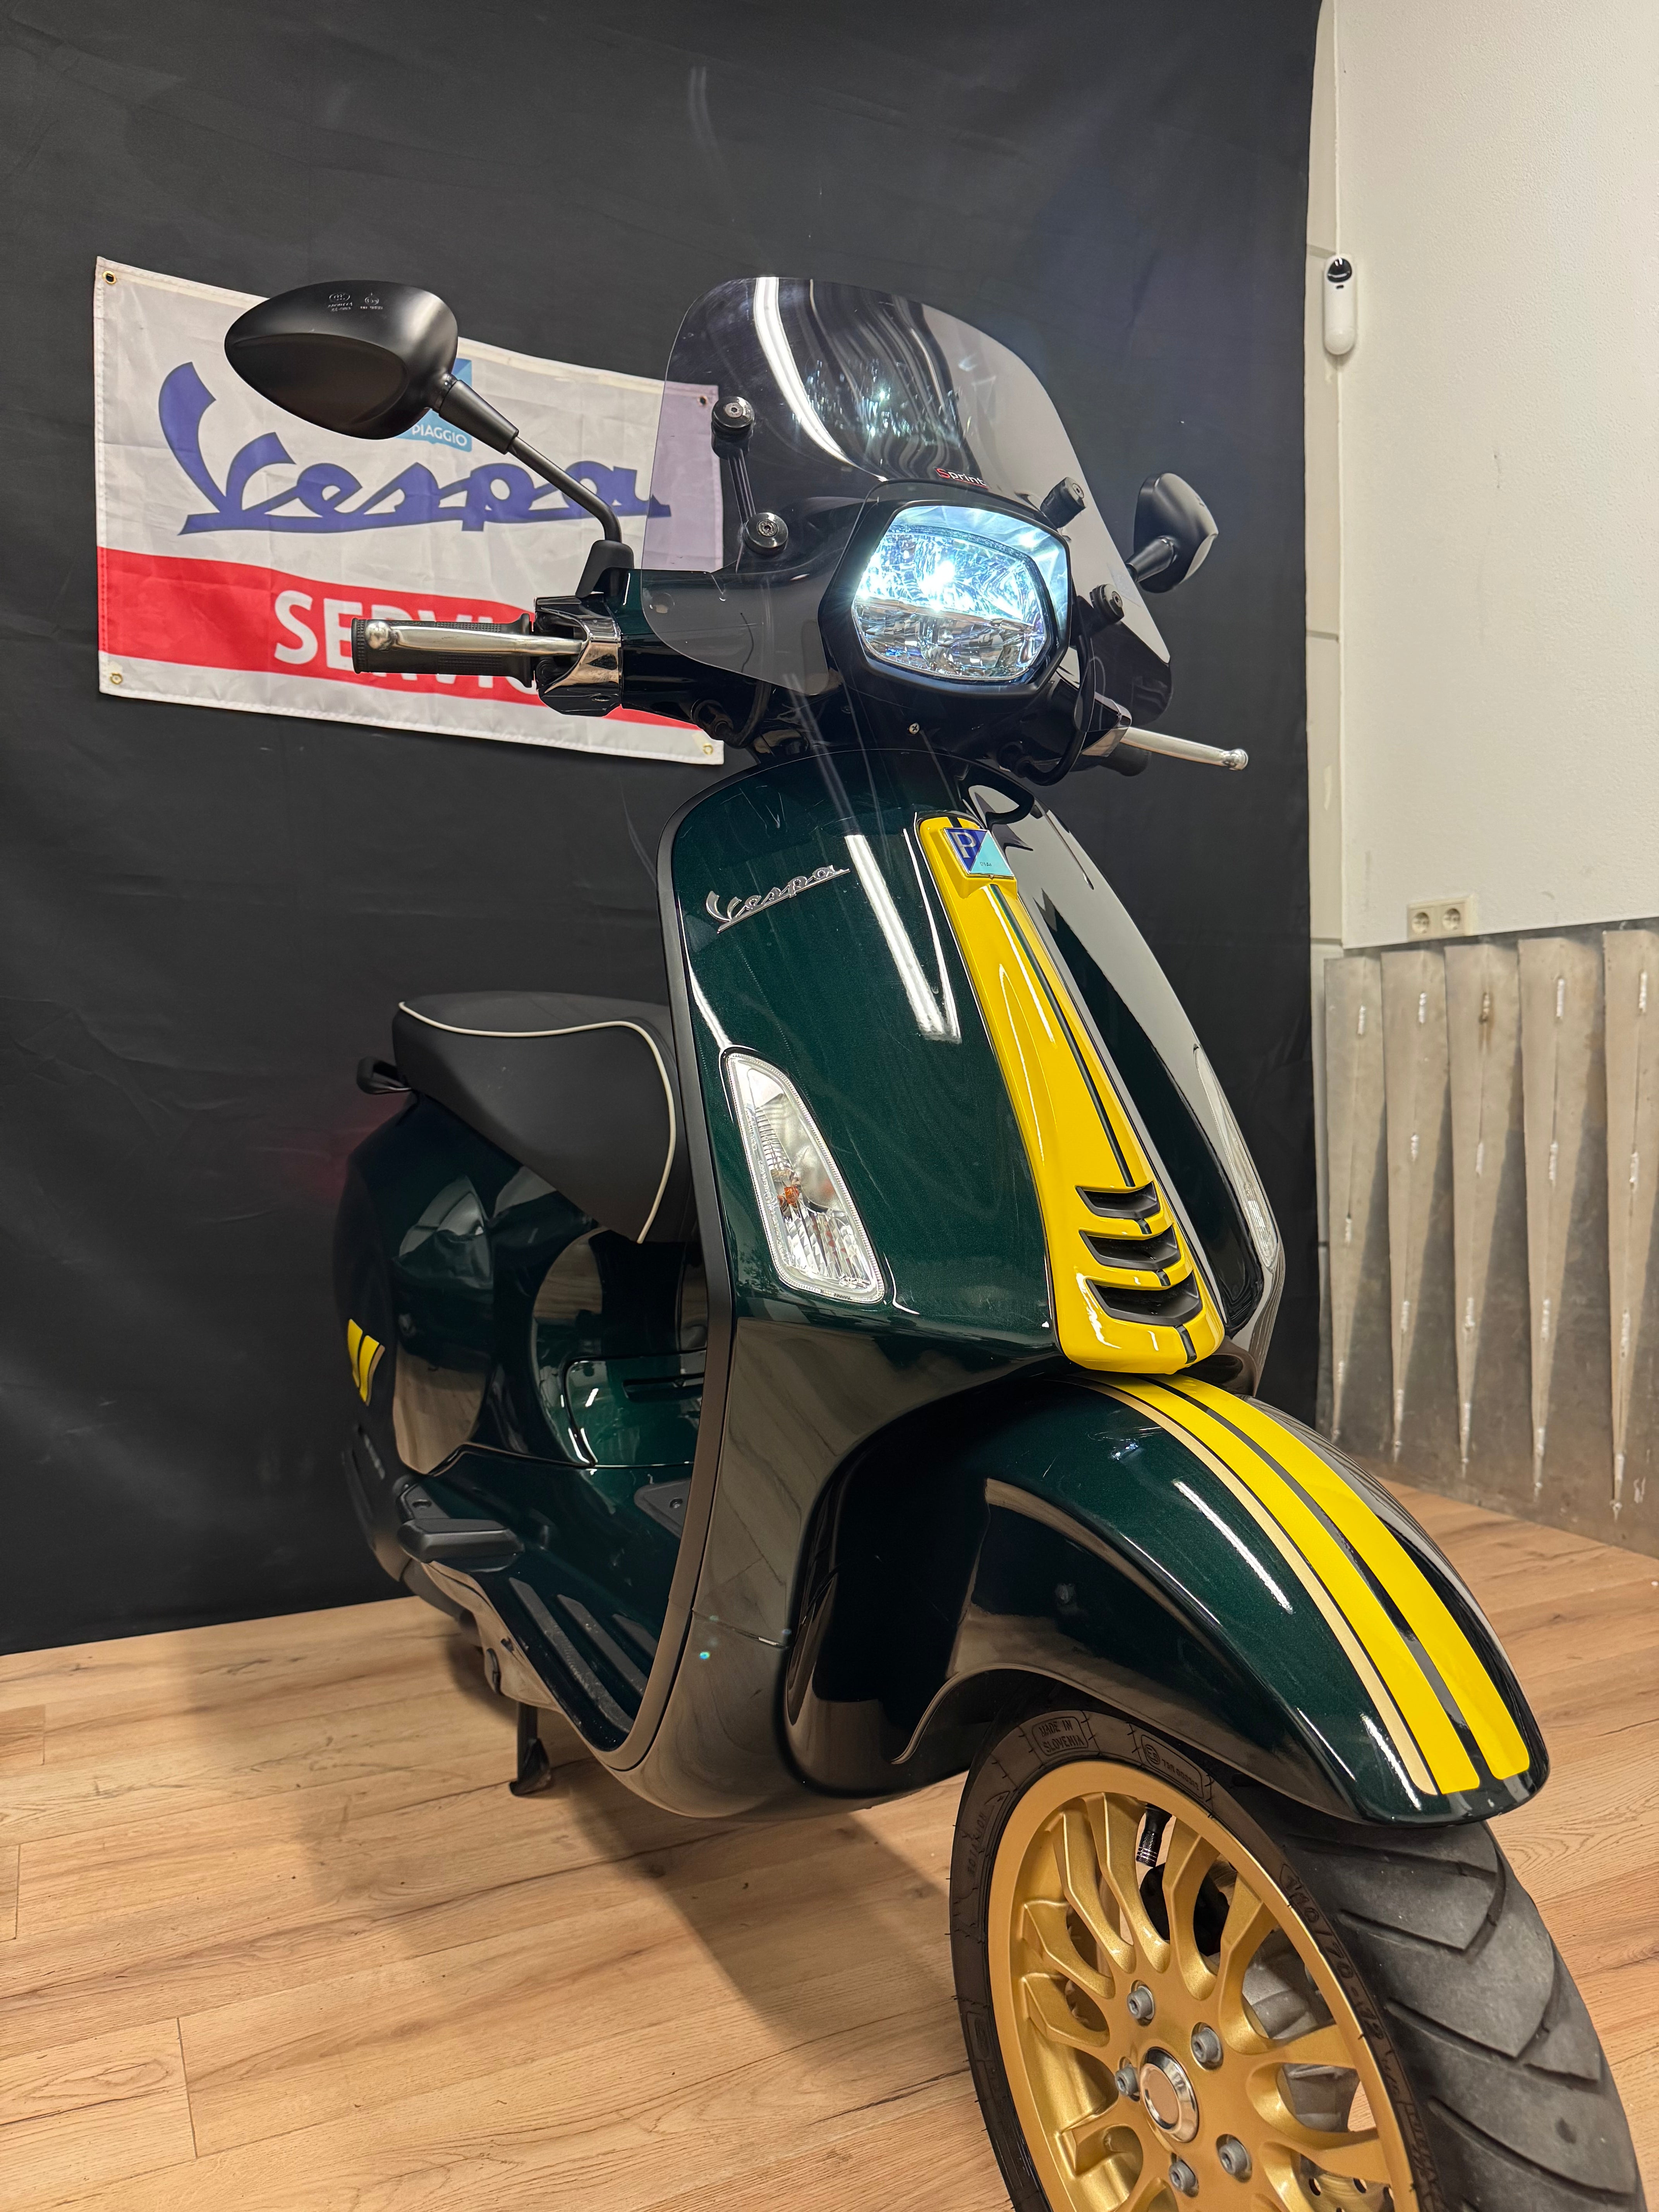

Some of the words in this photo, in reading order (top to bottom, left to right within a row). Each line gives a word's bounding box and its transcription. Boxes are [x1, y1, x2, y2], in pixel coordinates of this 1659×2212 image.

[412, 424, 467, 446] PIAGGIO
[158, 361, 672, 536] Vespa
[936, 468, 987, 487] Sprint
[950, 831, 977, 859] P
[705, 864, 851, 934] Vespa
[1038, 1721, 1061, 1738] MADE
[1062, 1719, 1073, 1731] IN
[1043, 1735, 1084, 1753] SLOVENIA
